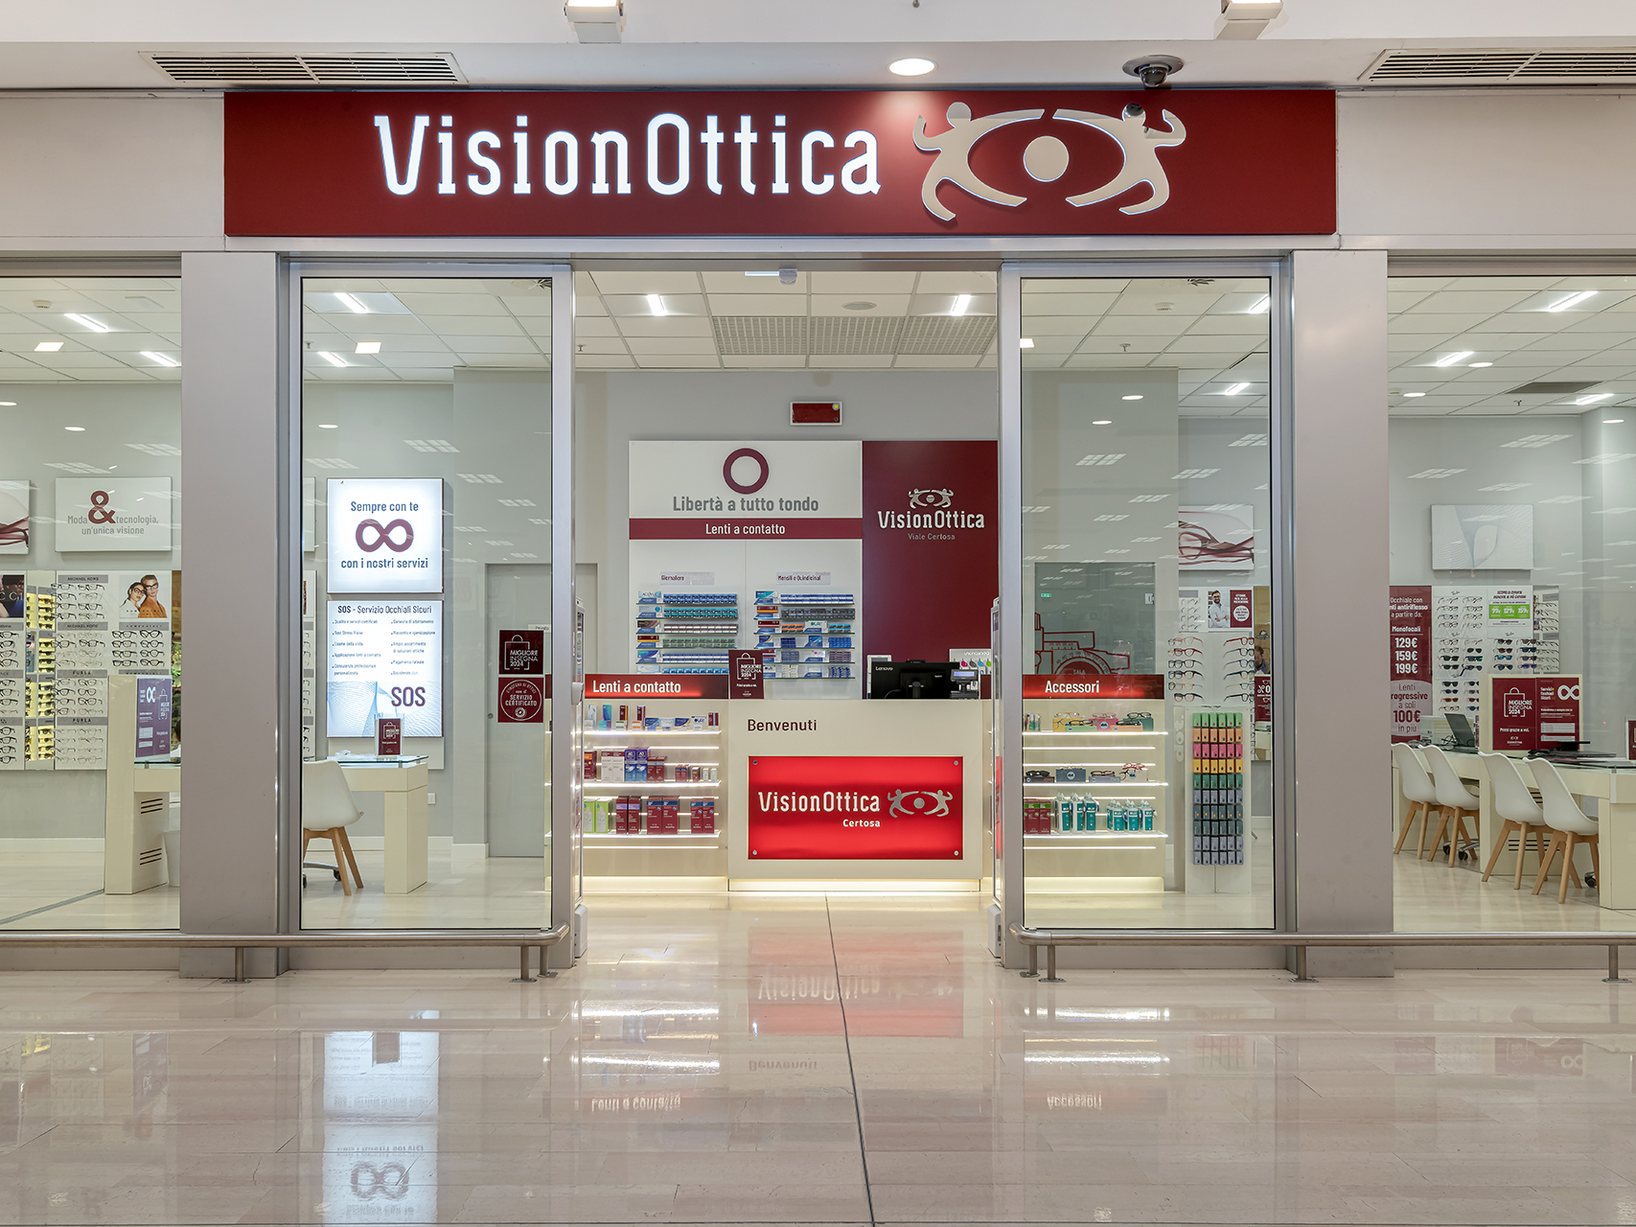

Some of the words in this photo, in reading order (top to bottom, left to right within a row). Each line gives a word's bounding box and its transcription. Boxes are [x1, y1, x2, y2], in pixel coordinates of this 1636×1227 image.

[374, 113, 881, 197] VisionOttica
[67, 515, 87, 524] Moda
[88, 490, 116, 524] &
[116, 515, 159, 525] tecnologia,
[350, 501, 387, 514] Sempre
[389, 503, 406, 512] con
[408, 502, 419, 512] te
[673, 496, 723, 511] Libertà
[727, 499, 736, 511] a
[740, 497, 775, 511] tutto
[779, 496, 819, 511] tondo
[877, 510, 985, 529] VisionOttica
[81, 526, 114, 535] un'unica
[117, 526, 144, 535] visione
[705, 523, 731, 535] Lenti
[734, 525, 740, 535] a
[742, 523, 786, 535] contatto
[341, 559, 358, 569] con
[366, 557, 394, 569] nostri
[397, 557, 429, 569] servizi
[337, 605, 351, 614] SOS
[357, 605, 384, 614] Servizio
[385, 605, 411, 614] Occhiali
[412, 605, 432, 614] Sicuri
[1394, 637, 1418, 648] 129€
[1394, 650, 1418, 661] 159€
[1394, 663, 1418, 674] 199€
[593, 680, 621, 693] Lenti
[624, 683, 631, 693] a
[633, 680, 681, 694] contatto
[1045, 680, 1100, 693] Accessori
[1398, 683, 1416, 691] Lenti
[391, 686, 426, 707] SOS
[1393, 710, 1421, 722] 100€
[747, 718, 818, 732] Benvenuti
[758, 791, 881, 812] VisionOttica
[843, 819, 881, 827] Certosa
